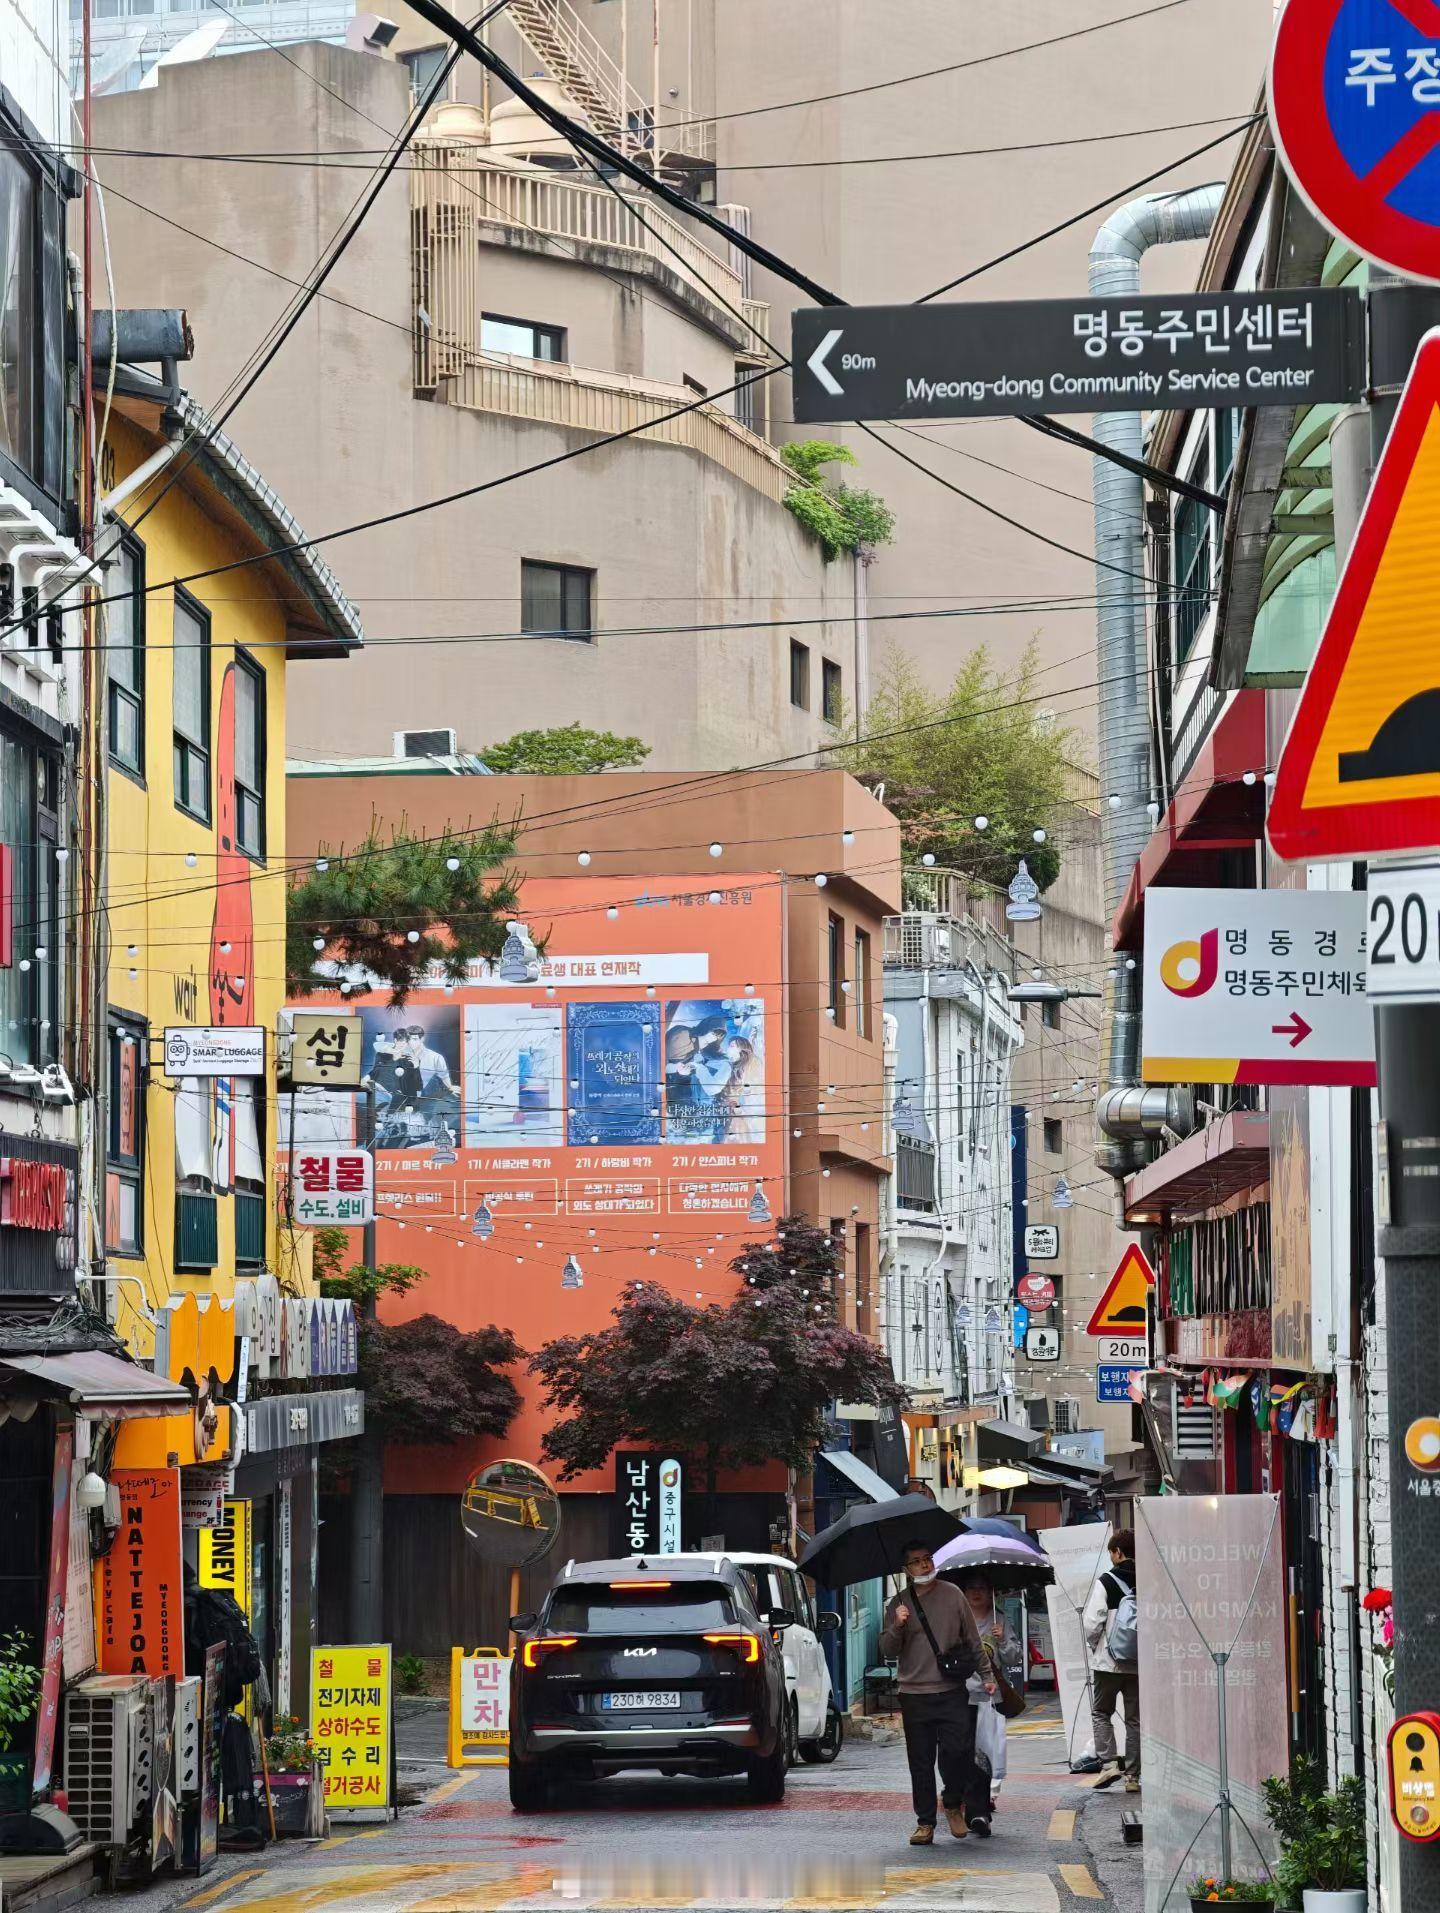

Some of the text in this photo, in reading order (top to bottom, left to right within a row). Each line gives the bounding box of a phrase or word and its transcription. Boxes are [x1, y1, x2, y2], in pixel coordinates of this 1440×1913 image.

[1073, 303, 1313, 358] 명동주민센터
[841, 354, 876, 370] 90m
[906, 366, 1314, 402] Myeong-dong Community Service Center
[672, 890, 753, 906] 서울경진흥원
[1371, 893, 1440, 965] 20
[570, 962, 597, 977] 대표
[601, 961, 641, 976] 연재작
[193, 1048, 262, 1057] SMAR LUGGAGE
[376, 1160, 392, 1171] 2기
[467, 1159, 482, 1169] 1기
[532, 1158, 552, 1169] 작가
[575, 1158, 591, 1168] 2기
[632, 1156, 653, 1167] 작가
[672, 1156, 688, 1167] 2기
[739, 1155, 758, 1166] 작가
[299, 1157, 365, 1192] 철물
[1109, 1343, 1147, 1357] 20m
[181, 1499, 213, 1508] urrency
[625, 1459, 652, 1558] 남산동
[127, 1506, 147, 1674] NATTEJOA
[159, 1583, 169, 1671] MYEONGDONG
[624, 1648, 658, 1658] KIA
[318, 1687, 381, 1707] 전기자제
[473, 1662, 503, 1728] 만차
[647, 1693, 677, 1706] 9834
[317, 1717, 382, 1737] 상하수도
[1402, 1781, 1435, 1798] 비상벨
